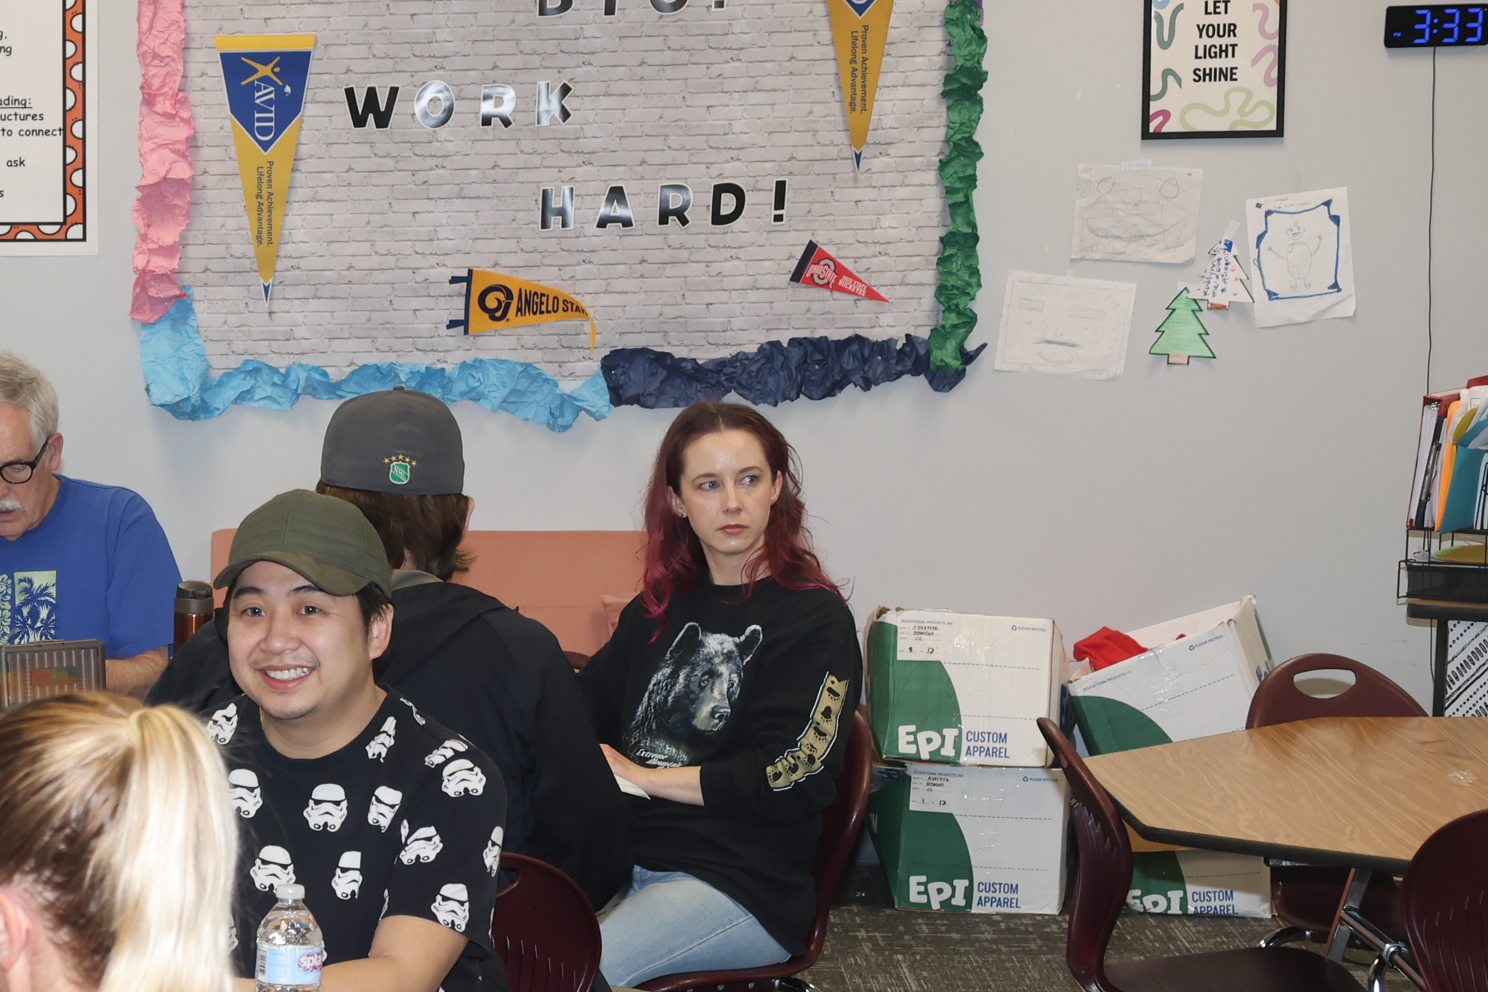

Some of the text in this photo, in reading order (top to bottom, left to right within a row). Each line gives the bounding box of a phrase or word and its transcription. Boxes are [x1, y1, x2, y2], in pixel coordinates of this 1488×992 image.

[1204, 0, 1230, 15] LET
[1196, 23, 1237, 38] YOUR
[1413, 8, 1483, 44] 3:33
[861, 25, 869, 54] Proven
[1194, 44, 1238, 59] LIGHT
[849, 31, 858, 114] Lifelong Advantage.
[1192, 67, 1238, 82] SHINE
[255, 80, 275, 141] AVID
[343, 80, 574, 130] WORK
[0, 127, 13, 137] to
[18, 127, 63, 137] connect
[6, 158, 25, 167] ask
[255, 166, 264, 247] Lifelong Advantage.
[539, 179, 788, 231] HARD!
[515, 287, 559, 317] ANGELO
[898, 724, 1007, 760] EPI CUSTOM
[965, 745, 1010, 759] APPAREL
[909, 875, 1019, 910] EPI CUSTOM
[1192, 890, 1233, 902] CUSTOM
[977, 896, 1021, 909] APPAREL
[1193, 905, 1238, 915] APPAREL
[300, 953, 323, 968] spla
